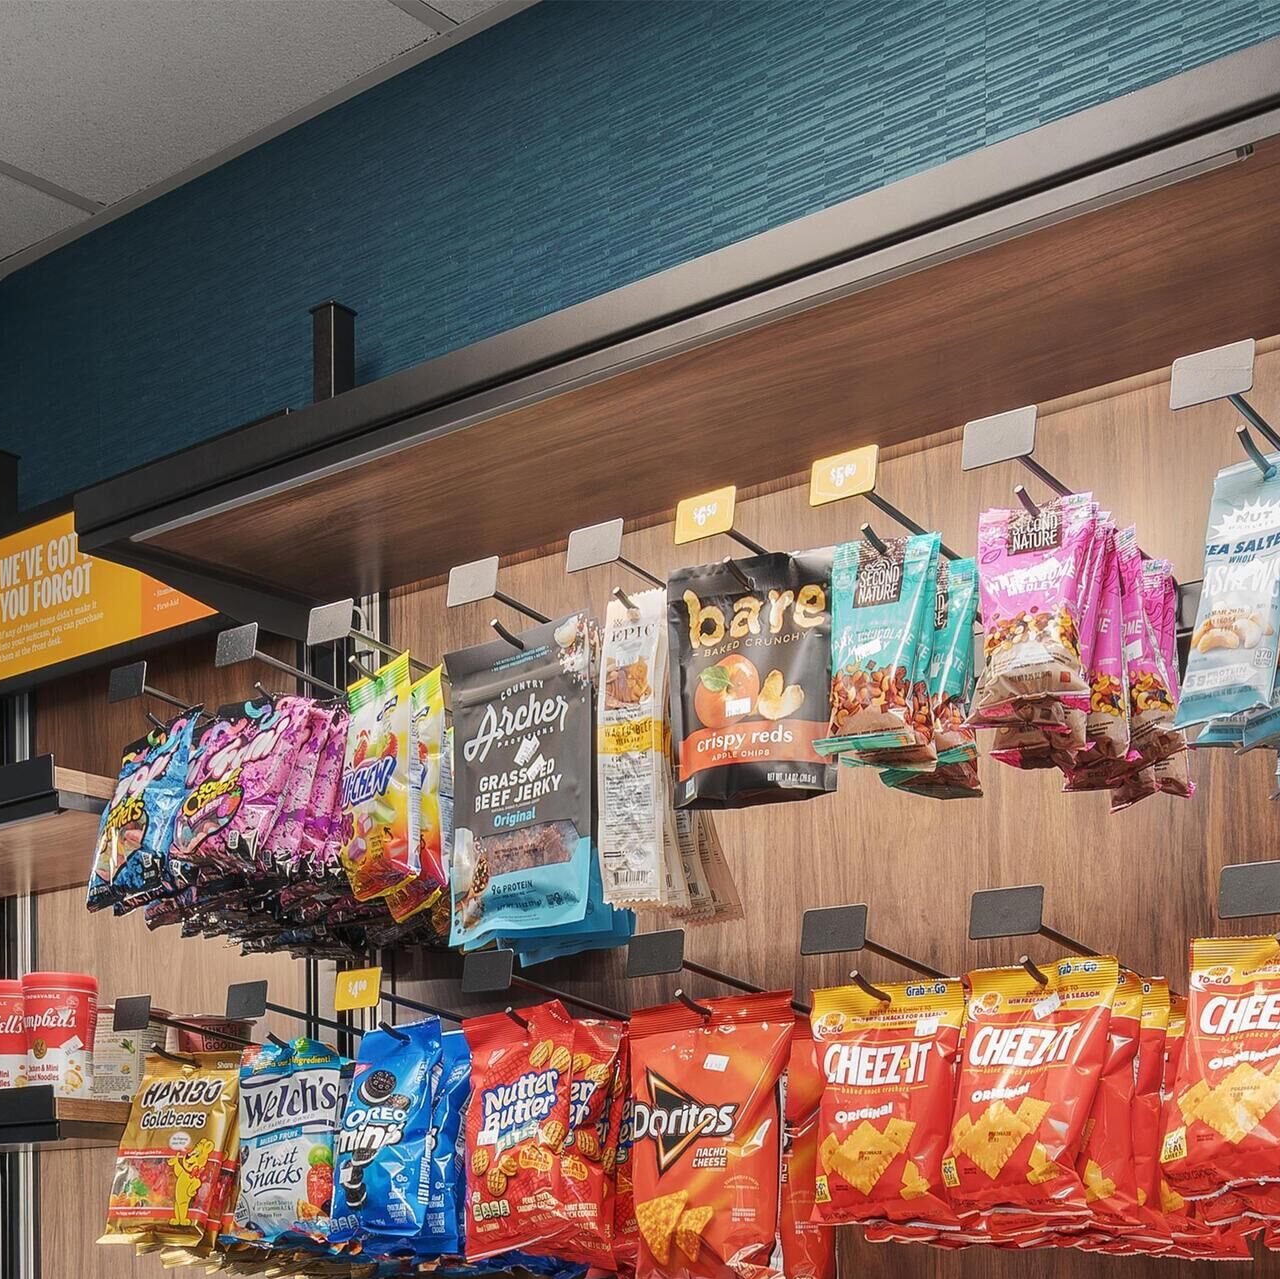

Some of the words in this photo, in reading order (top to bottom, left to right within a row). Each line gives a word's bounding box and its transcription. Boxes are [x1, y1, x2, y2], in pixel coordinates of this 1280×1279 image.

[1013, 530, 1057, 551] NATURE
[0, 546, 43, 590] WE'VE
[47, 532, 78, 572] GOT
[860, 566, 899, 587] SECOND
[0, 583, 29, 623] YOU
[34, 562, 93, 612] FORGOT
[858, 583, 898, 605] NATURE
[683, 584, 826, 649] bare
[611, 624, 655, 642] EPIC
[704, 639, 740, 657] BAKED
[745, 631, 809, 647] CRUNCHY
[501, 680, 544, 701] COUNTRY
[464, 693, 569, 763] Archer
[697, 732, 745, 753] crispy
[751, 725, 793, 744] reds
[712, 751, 737, 761] APPLE
[741, 749, 769, 757] CHIPS
[475, 789, 511, 813] BEEF
[514, 774, 562, 803] JERKY
[493, 807, 536, 828] Original
[503, 880, 532, 893] PROTEIN
[906, 985, 925, 996] Grab
[935, 983, 946, 994] Go
[141, 1081, 223, 1109] HARIBO
[243, 1076, 337, 1128] Welch's
[485, 1070, 558, 1116] Nutter
[141, 1111, 205, 1129] Goldbears
[346, 1108, 406, 1127] OREO
[485, 1094, 555, 1132] Butter
[633, 1102, 736, 1138] Doritos
[692, 1157, 727, 1168] CHEESE
[696, 1147, 727, 1158] NACHO
[243, 1165, 303, 1193] Snacks
